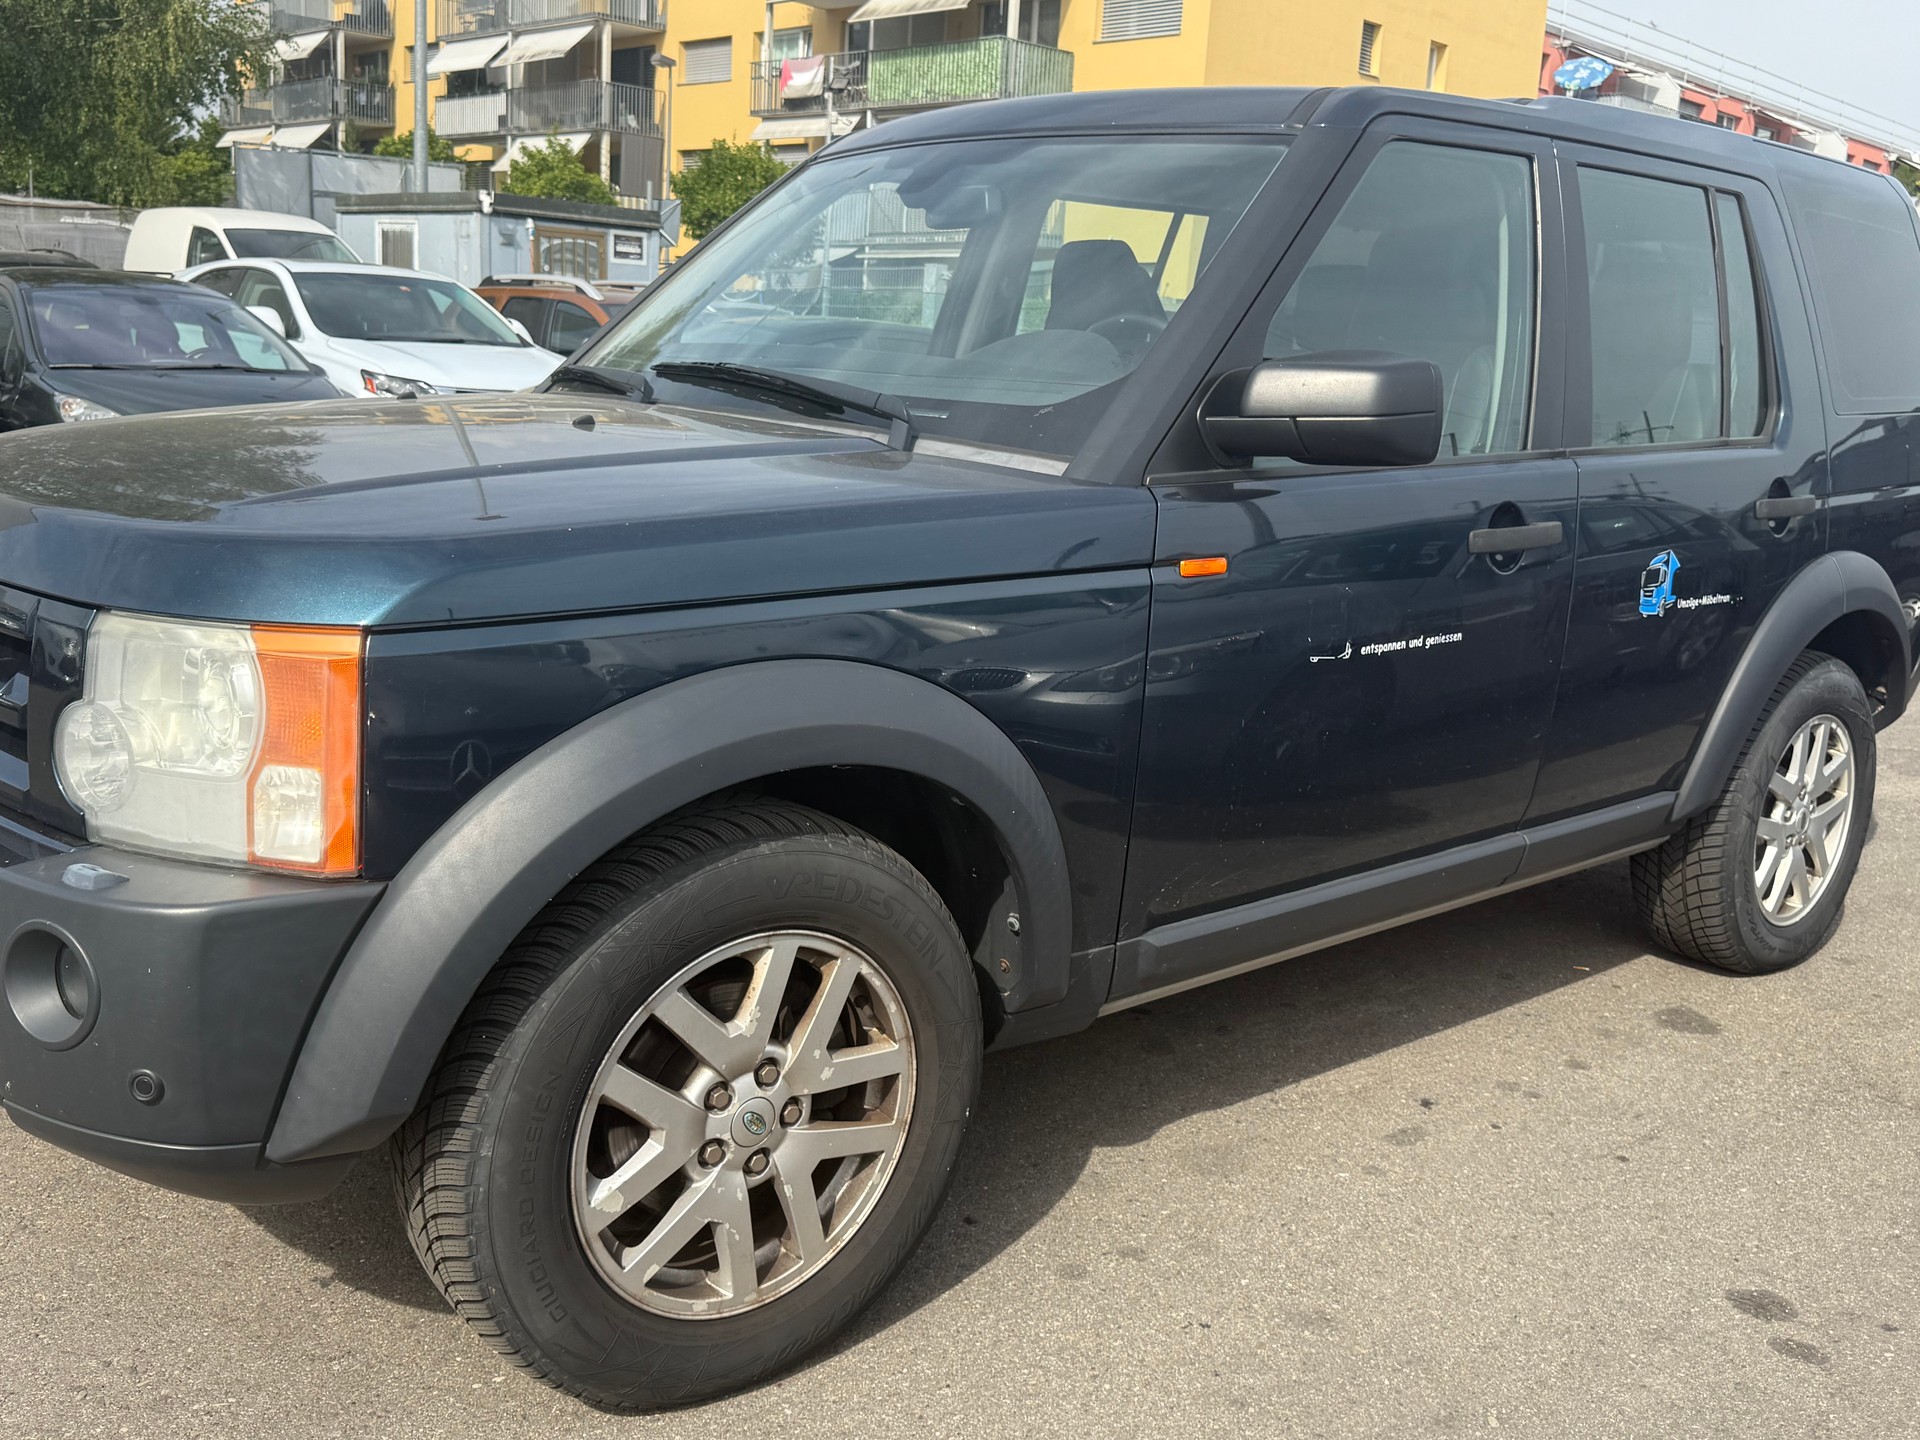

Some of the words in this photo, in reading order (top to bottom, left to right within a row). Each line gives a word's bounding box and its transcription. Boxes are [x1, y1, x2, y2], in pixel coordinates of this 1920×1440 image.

[1360, 640, 1406, 656] entspannen
[1408, 635, 1424, 649] und
[1425, 632, 1463, 649] geniessen
[766, 870, 946, 970] VREDESTEIN
[519, 1069, 562, 1185] DESIGN
